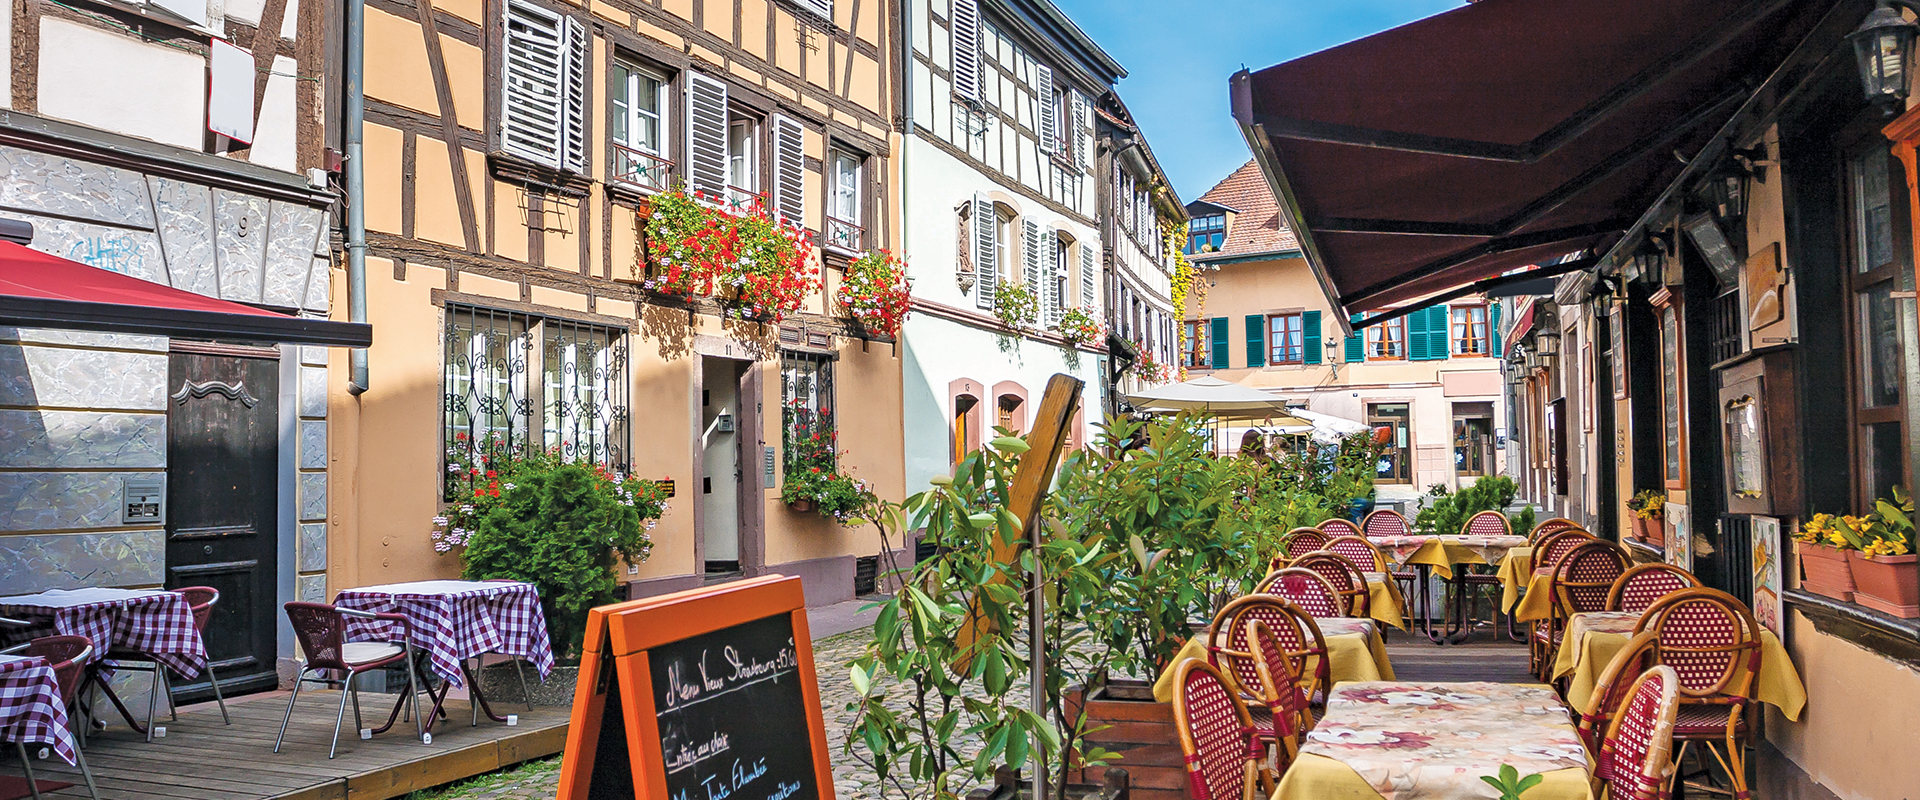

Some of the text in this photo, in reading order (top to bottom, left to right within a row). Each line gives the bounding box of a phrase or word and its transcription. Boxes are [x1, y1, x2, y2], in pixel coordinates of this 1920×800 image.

[238, 216, 248, 238] 9
[725, 344, 732, 356] 11
[666, 661, 699, 707] Menu
[698, 649, 723, 692] Vieux
[724, 645, 778, 684] Strasbourg
[663, 731, 729, 768] Entrée au choix
